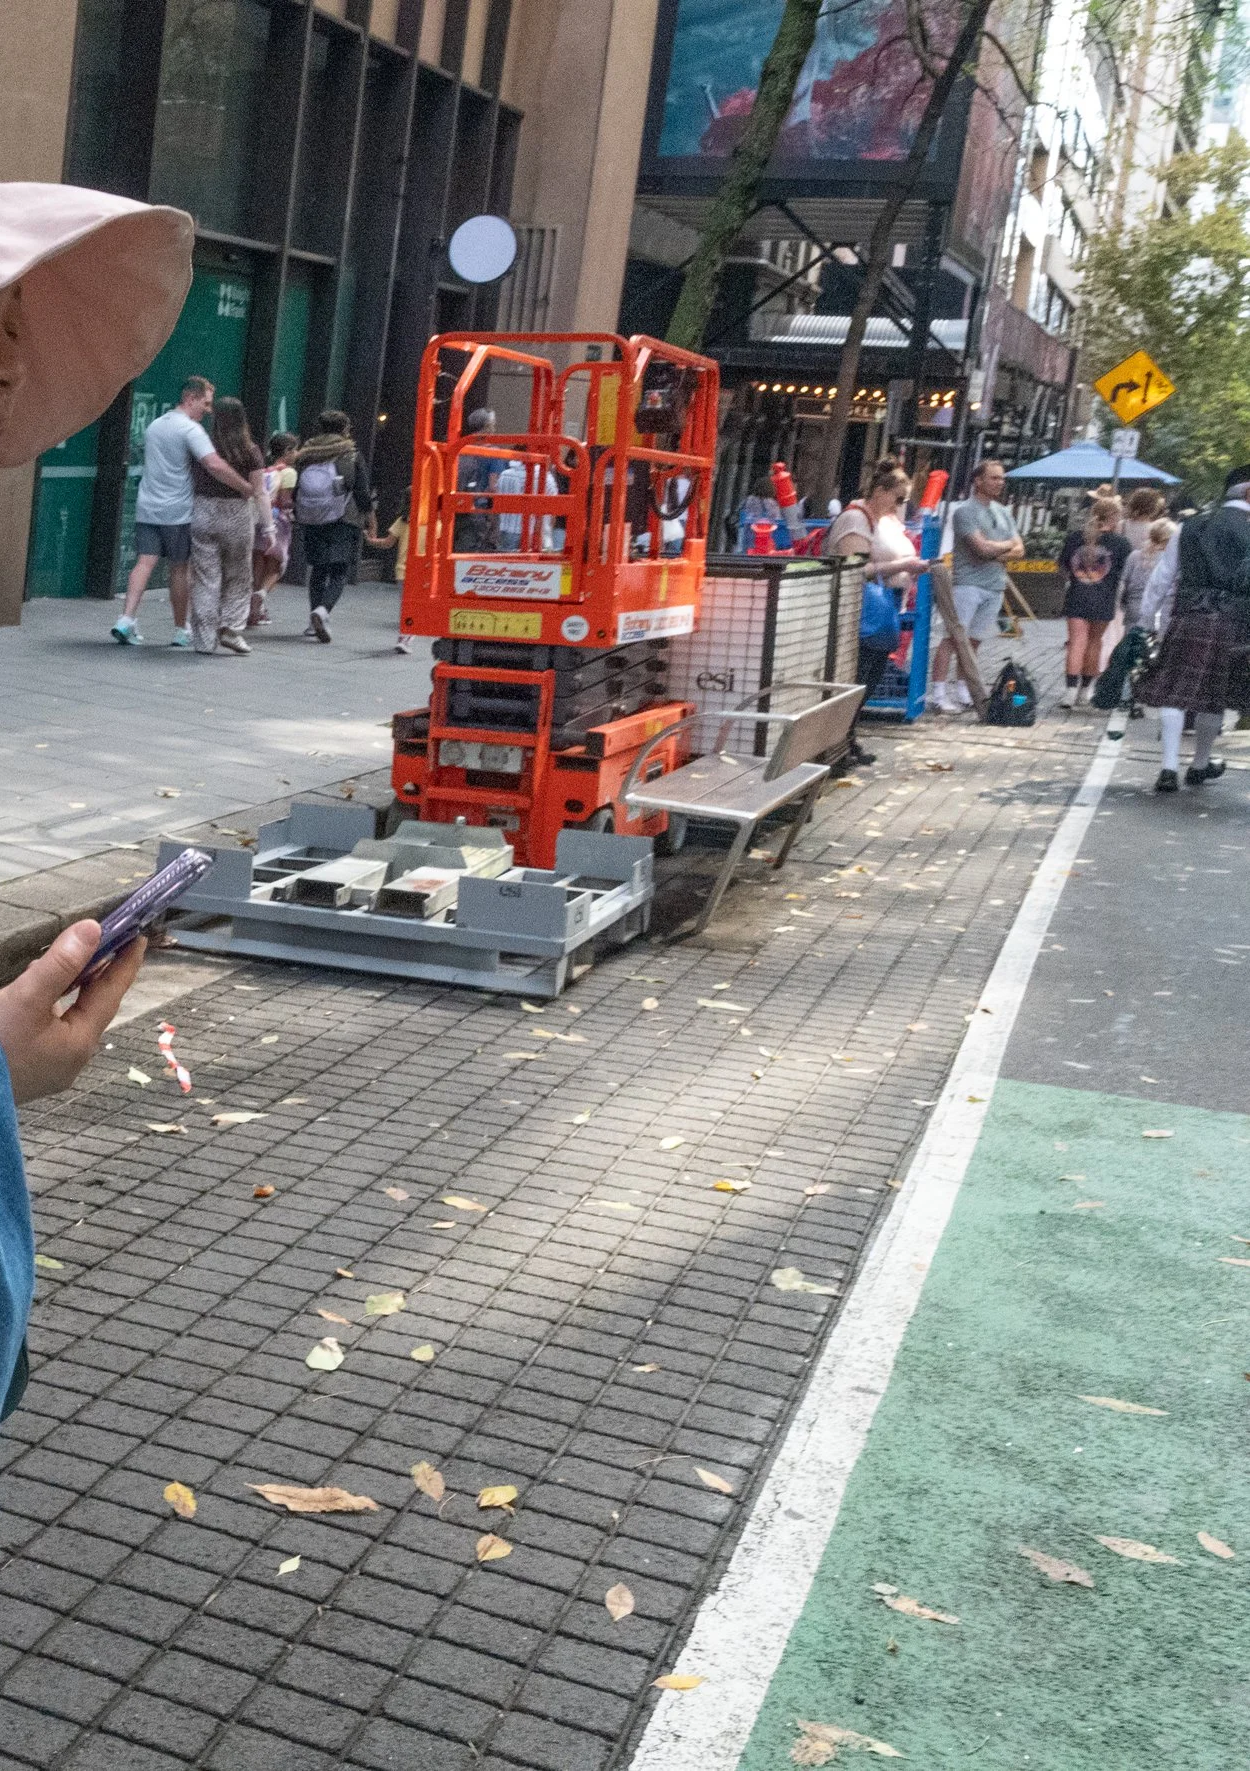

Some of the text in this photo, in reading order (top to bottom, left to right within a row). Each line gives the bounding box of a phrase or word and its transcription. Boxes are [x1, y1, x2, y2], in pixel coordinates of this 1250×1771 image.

[460, 577, 530, 586] access
[465, 564, 554, 582] Botany
[696, 668, 734, 693] esi
